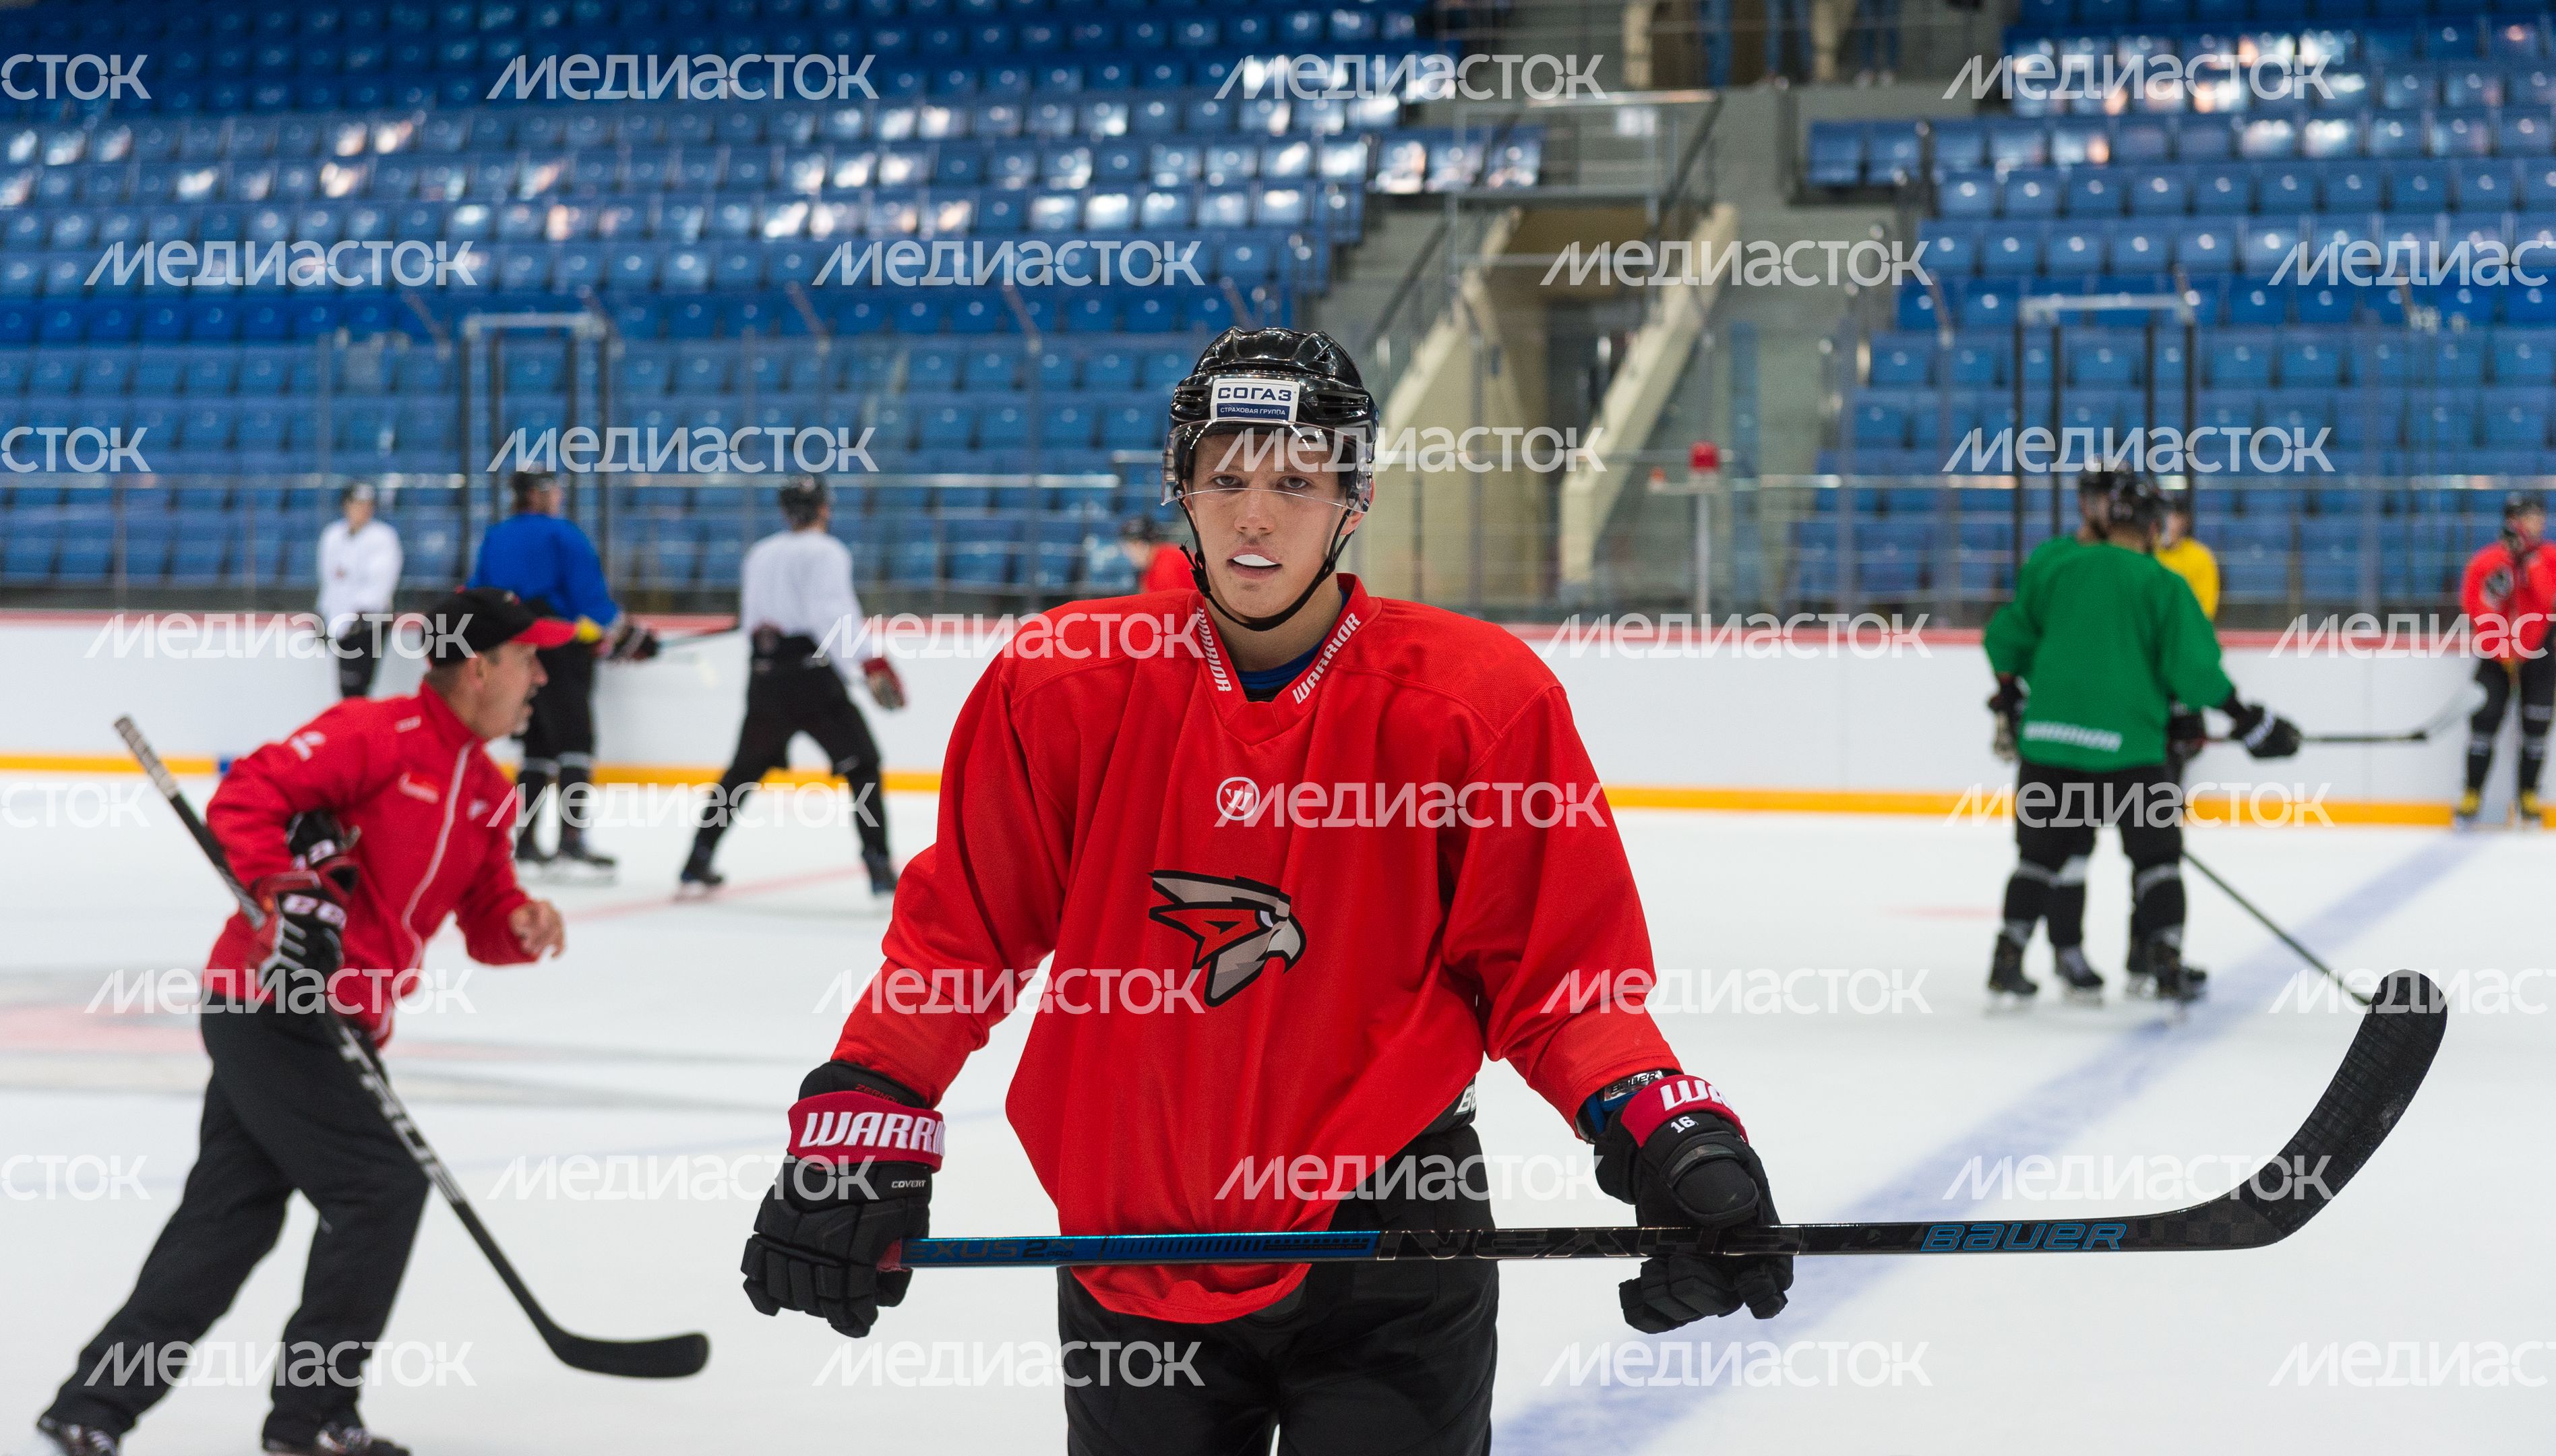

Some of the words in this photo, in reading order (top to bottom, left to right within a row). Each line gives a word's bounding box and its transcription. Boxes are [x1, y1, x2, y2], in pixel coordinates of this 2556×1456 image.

[1217, 387, 1292, 402] СОГАЗ
[1220, 406, 1258, 415] СТРАХОВАЯ
[1259, 408, 1286, 416] ГРУППА
[1292, 612, 1362, 705] WARRIOR
[1670, 1116, 1696, 1134] 16
[891, 1179, 927, 1189] COVERT
